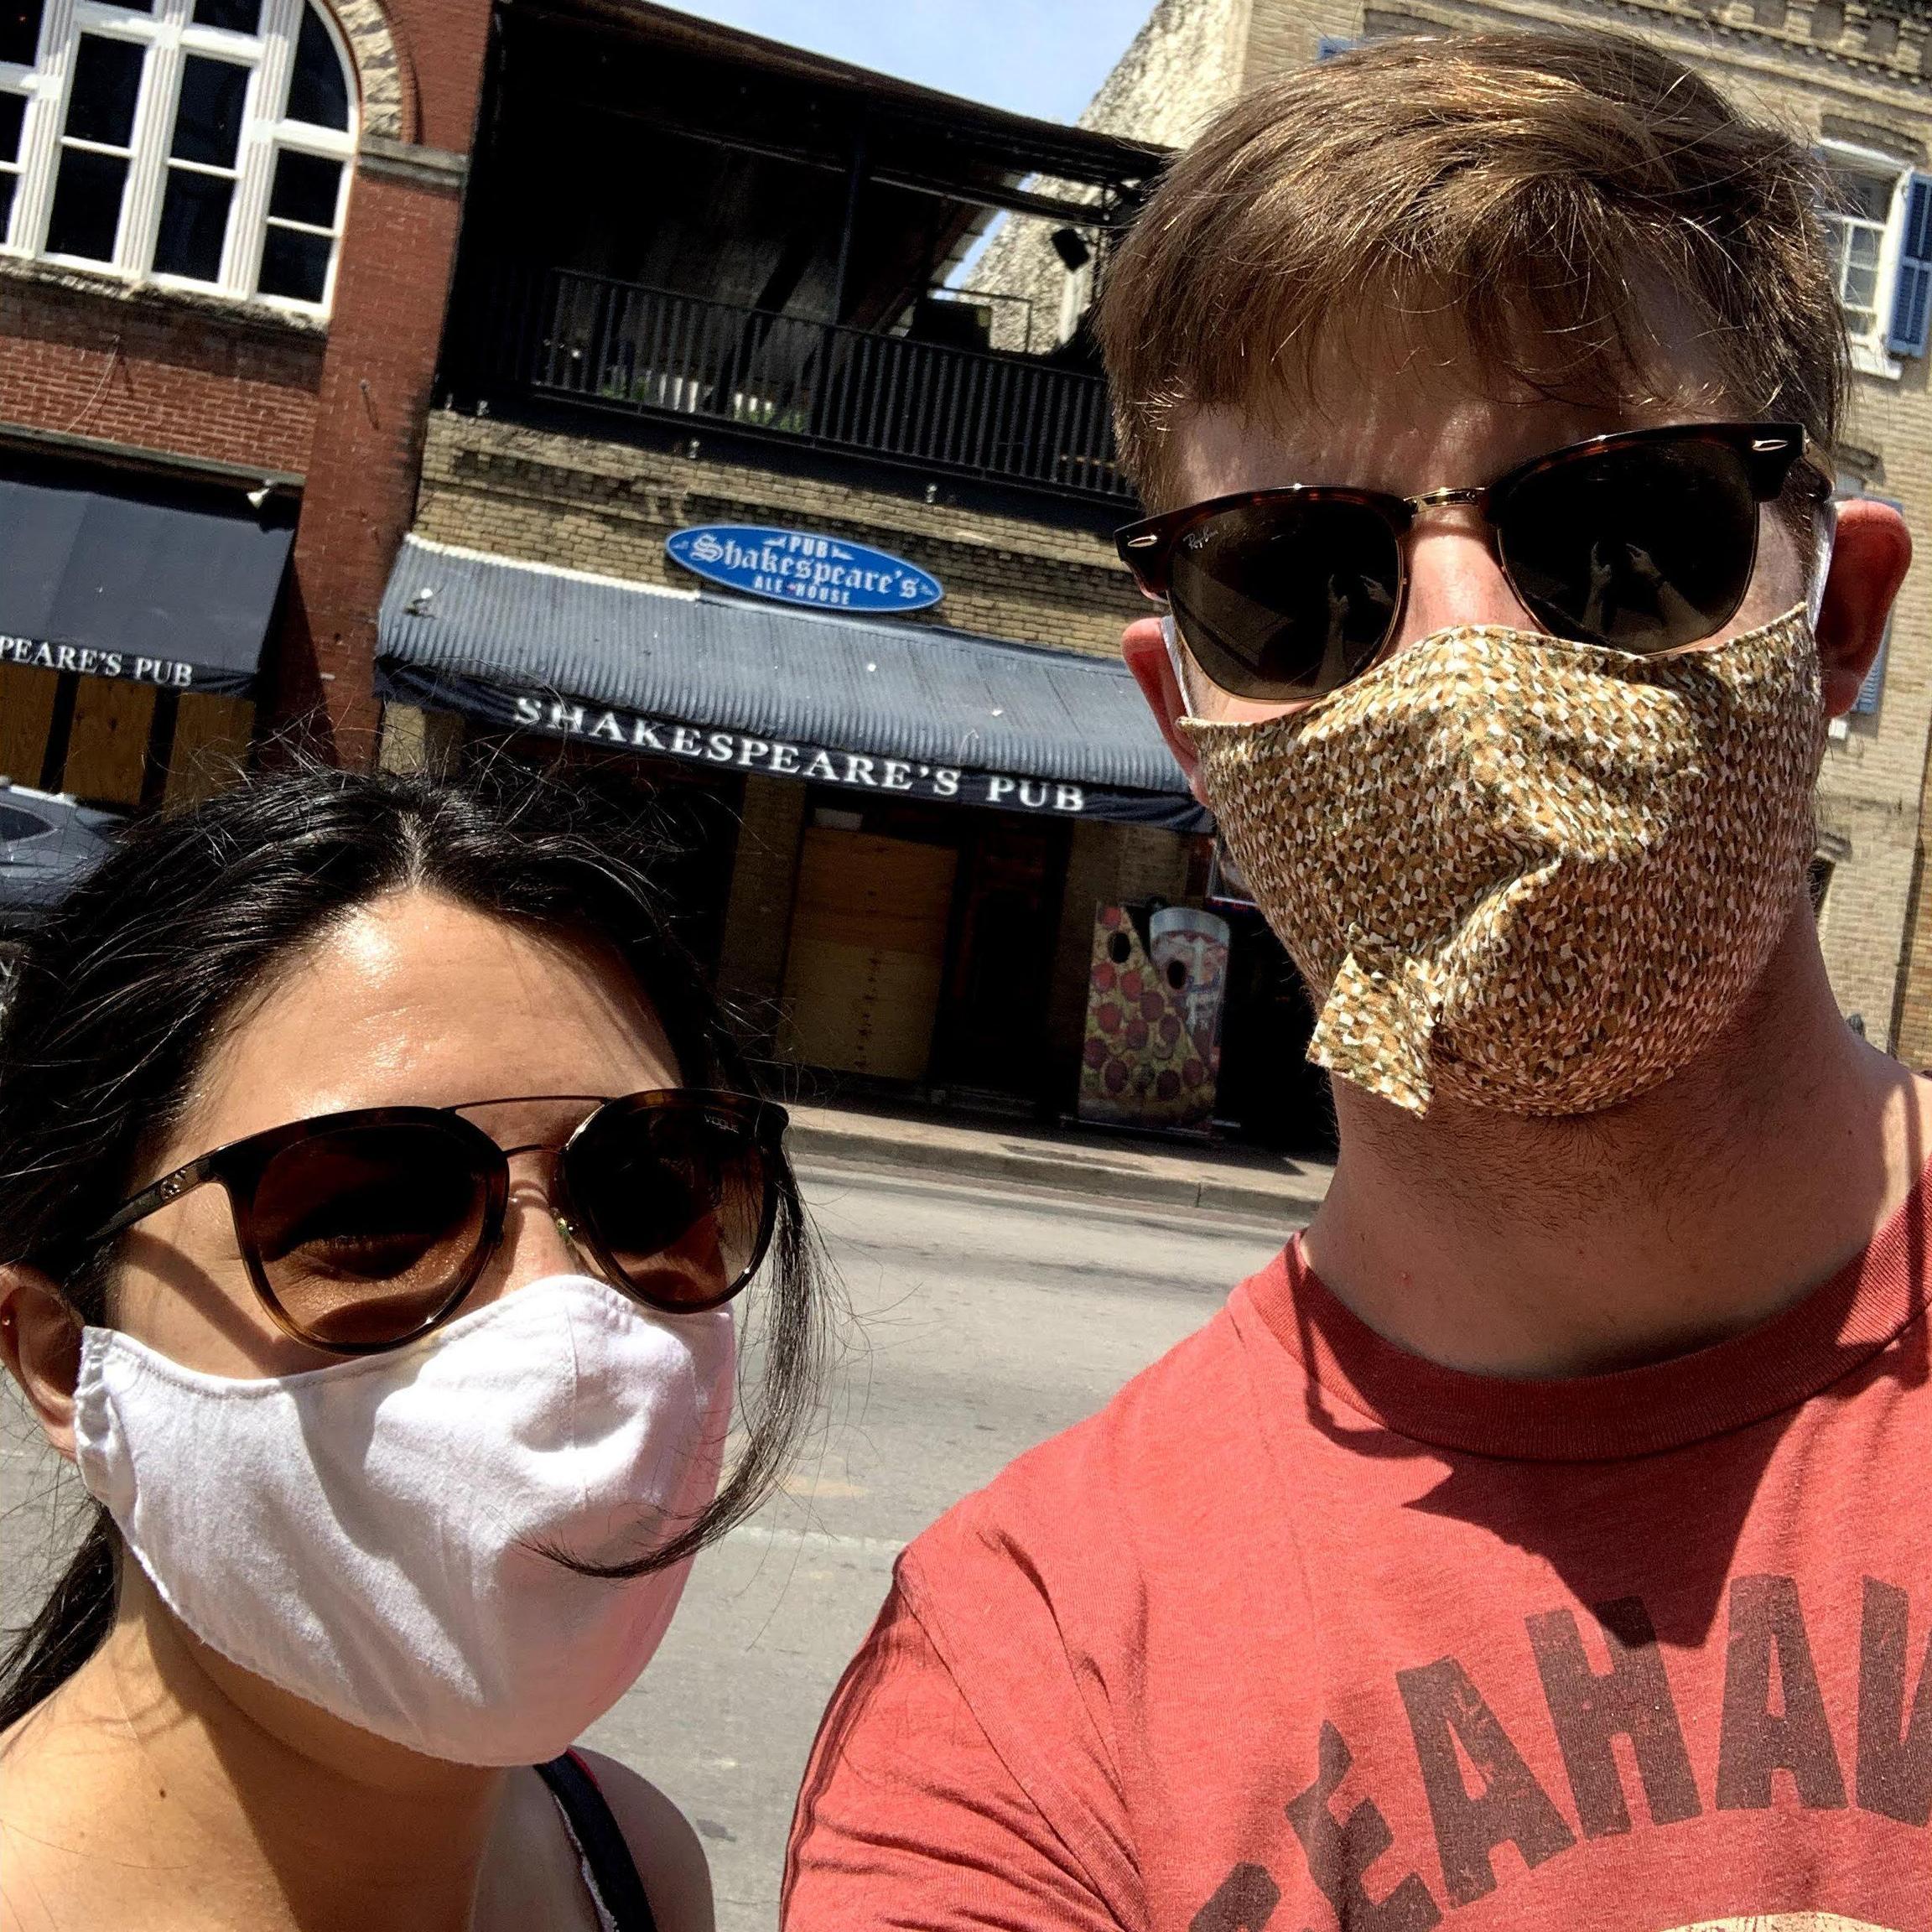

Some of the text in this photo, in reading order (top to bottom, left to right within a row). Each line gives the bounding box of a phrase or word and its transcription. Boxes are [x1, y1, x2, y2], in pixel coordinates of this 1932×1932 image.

[690, 533, 919, 600] Shakespeare's
[789, 536, 828, 558] PUB
[0, 635, 194, 687] PEARE'S PUB
[514, 697, 1085, 812] SHAKESPEARE'S PUB
